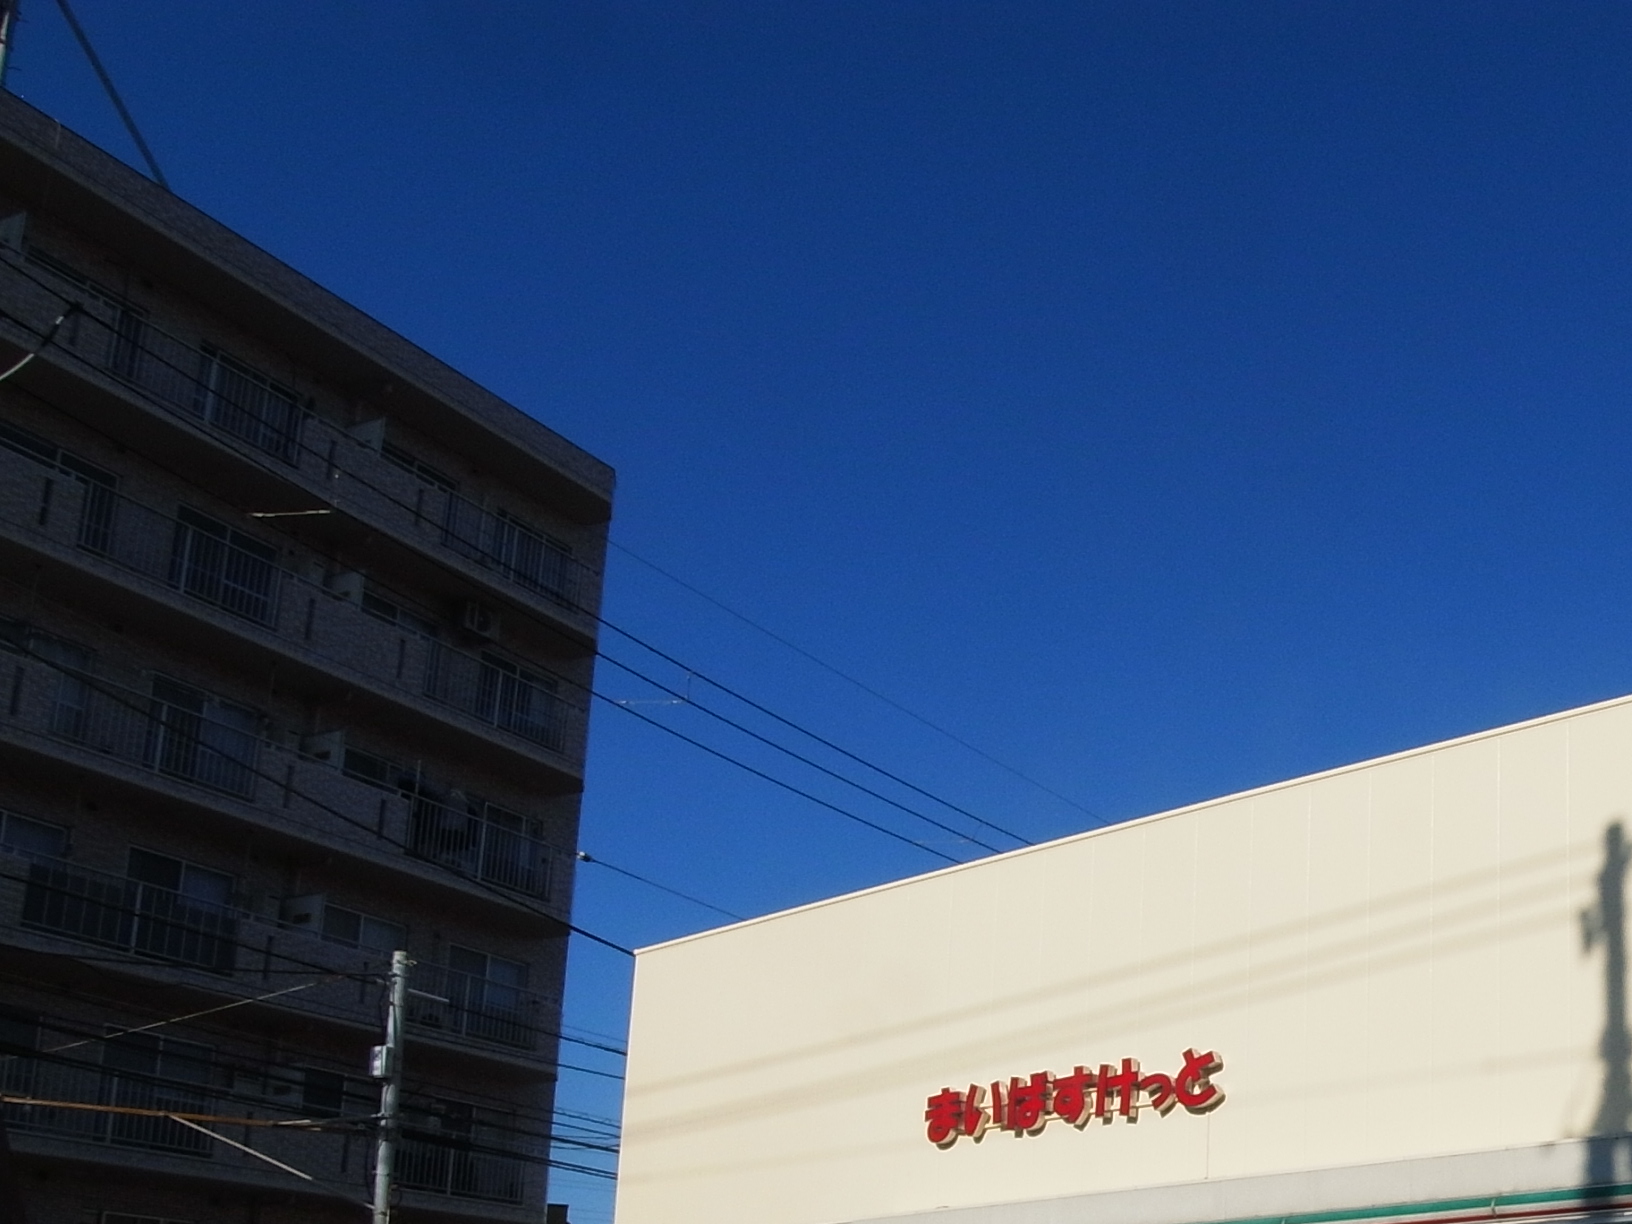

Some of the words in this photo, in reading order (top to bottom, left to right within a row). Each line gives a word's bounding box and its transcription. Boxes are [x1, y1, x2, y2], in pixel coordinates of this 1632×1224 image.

[924, 1048, 1226, 1146] まいばすけっと
